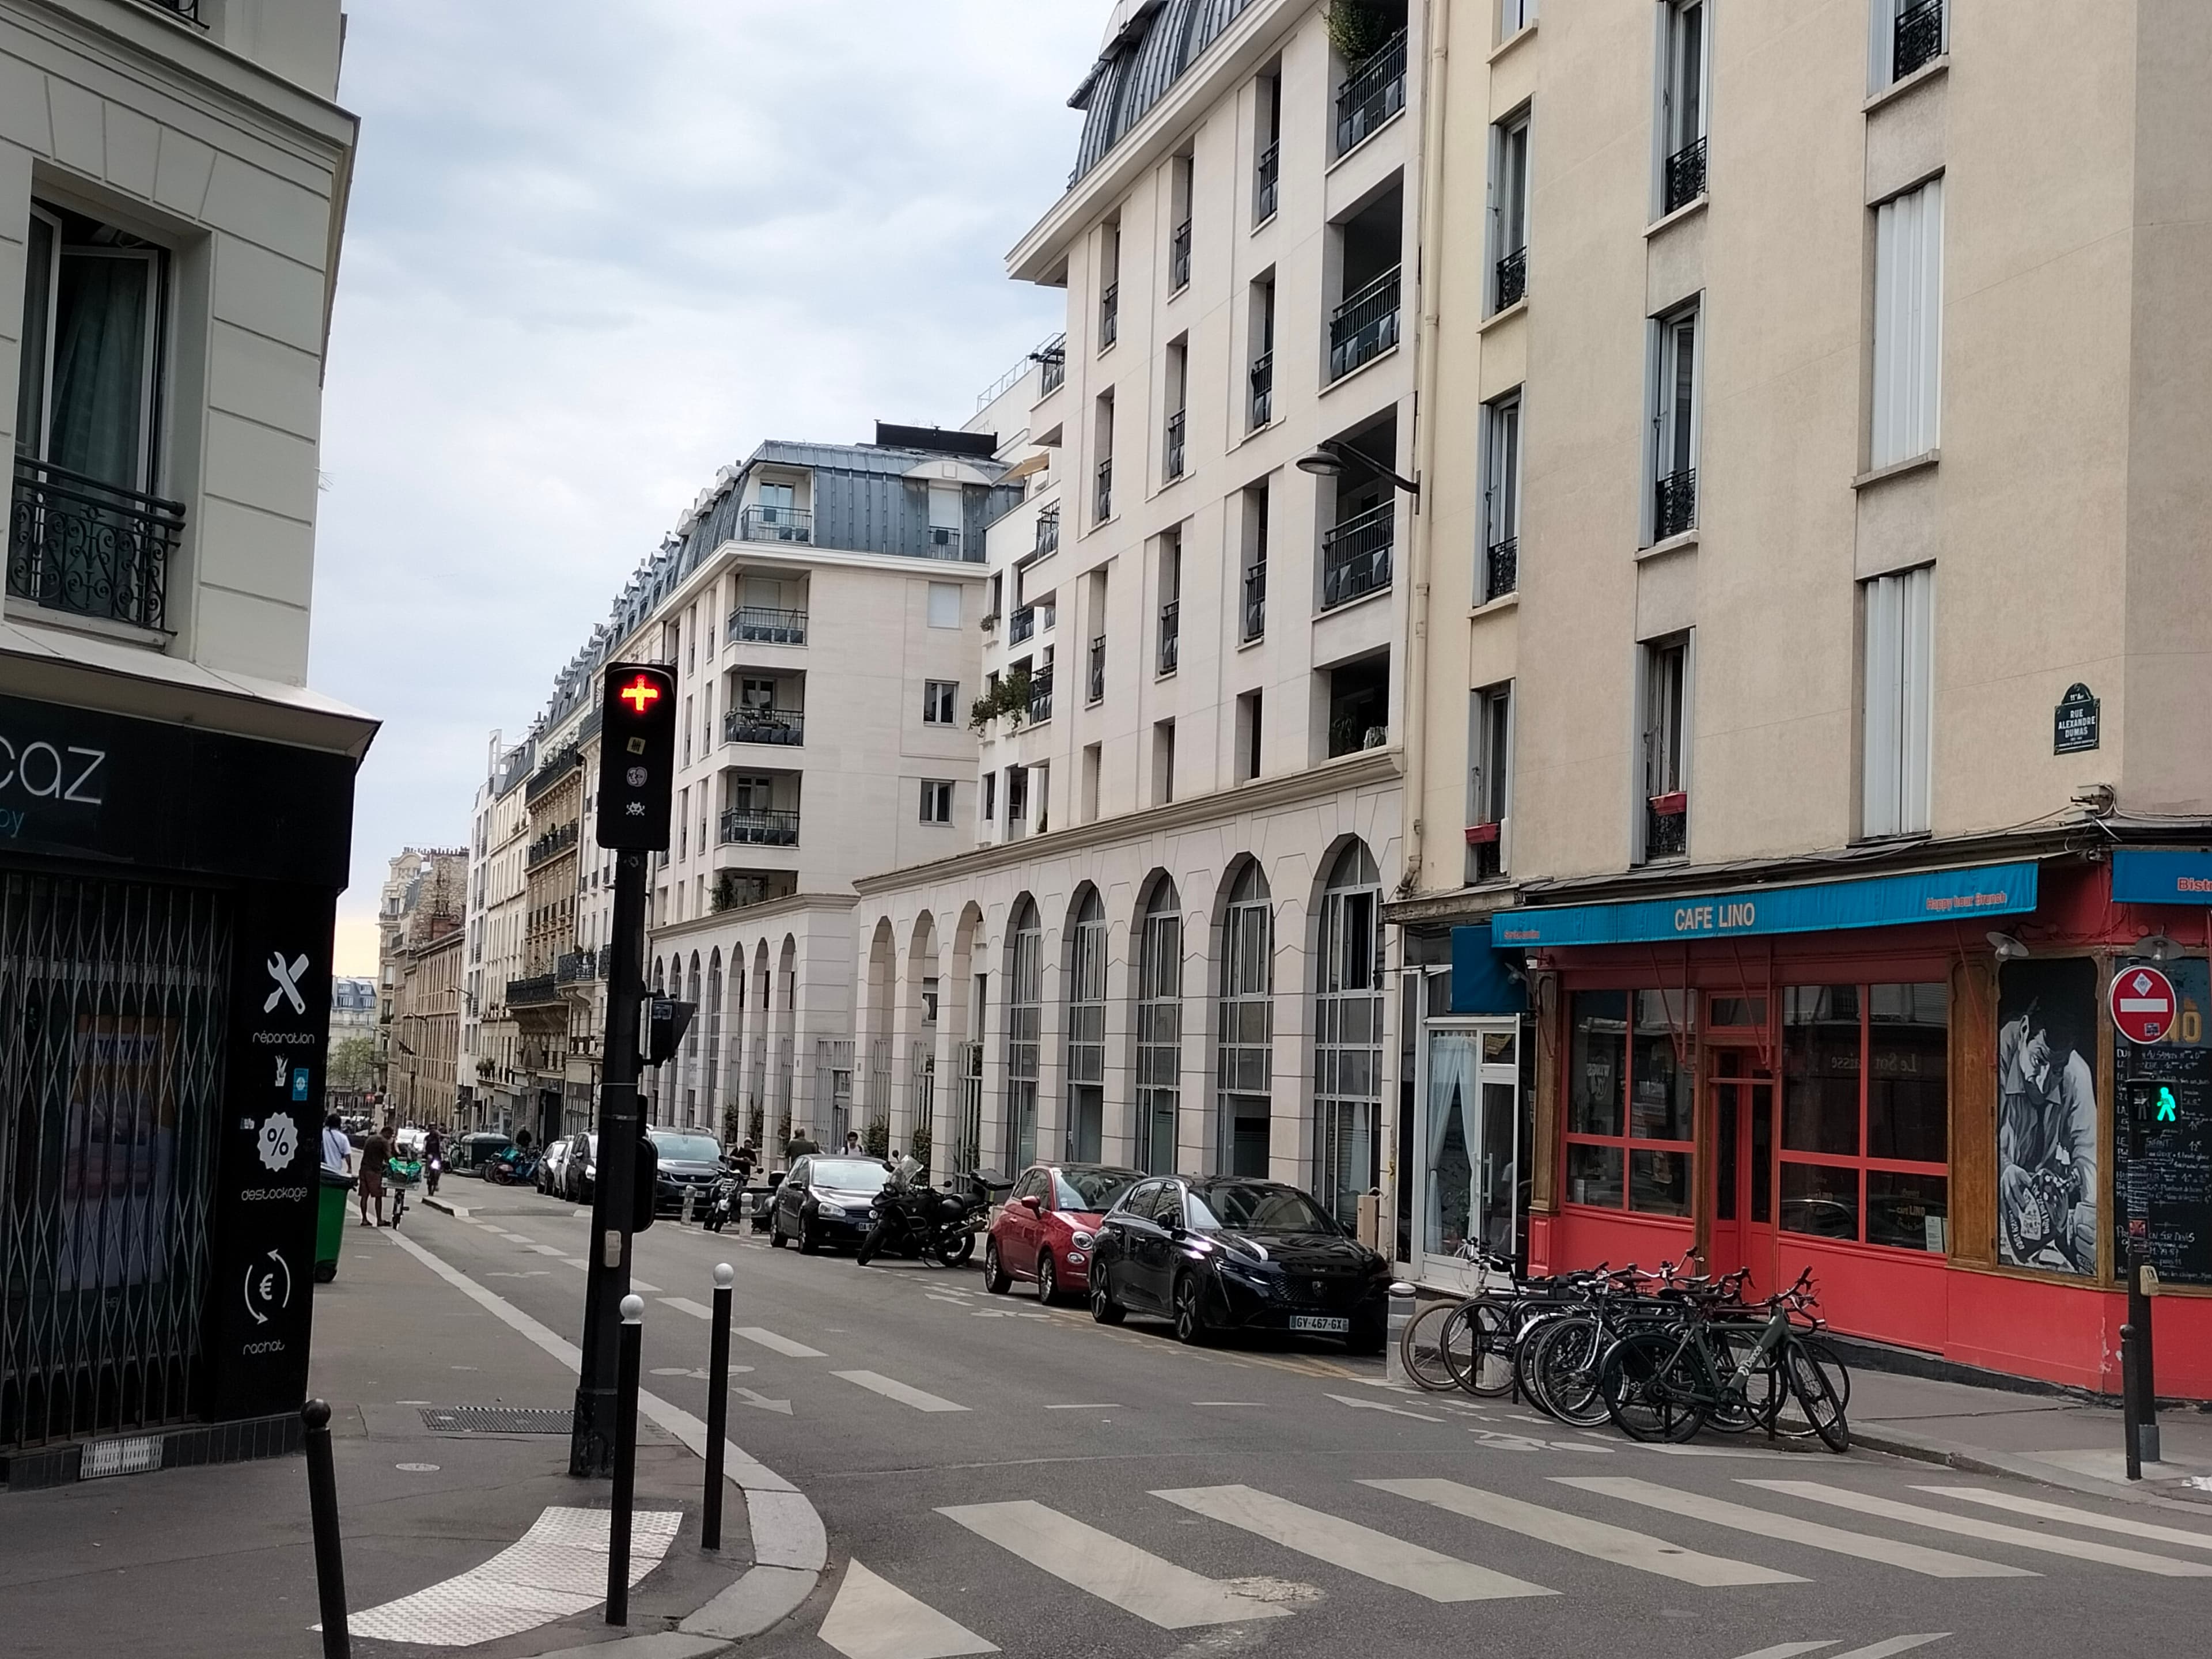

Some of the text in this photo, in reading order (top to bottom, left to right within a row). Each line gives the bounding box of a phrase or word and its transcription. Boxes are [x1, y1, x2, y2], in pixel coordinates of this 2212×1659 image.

[2070, 709, 2084, 719] RUE
[2058, 716, 2096, 730] ALEXANDRE
[2065, 726, 2088, 738] DUMAS
[1926, 897, 1953, 912] Happy
[1675, 902, 1755, 931] CAFE LINO
[252, 1030, 315, 1044] réparation
[241, 1187, 308, 1202] destockage
[243, 1339, 285, 1355] rachat
